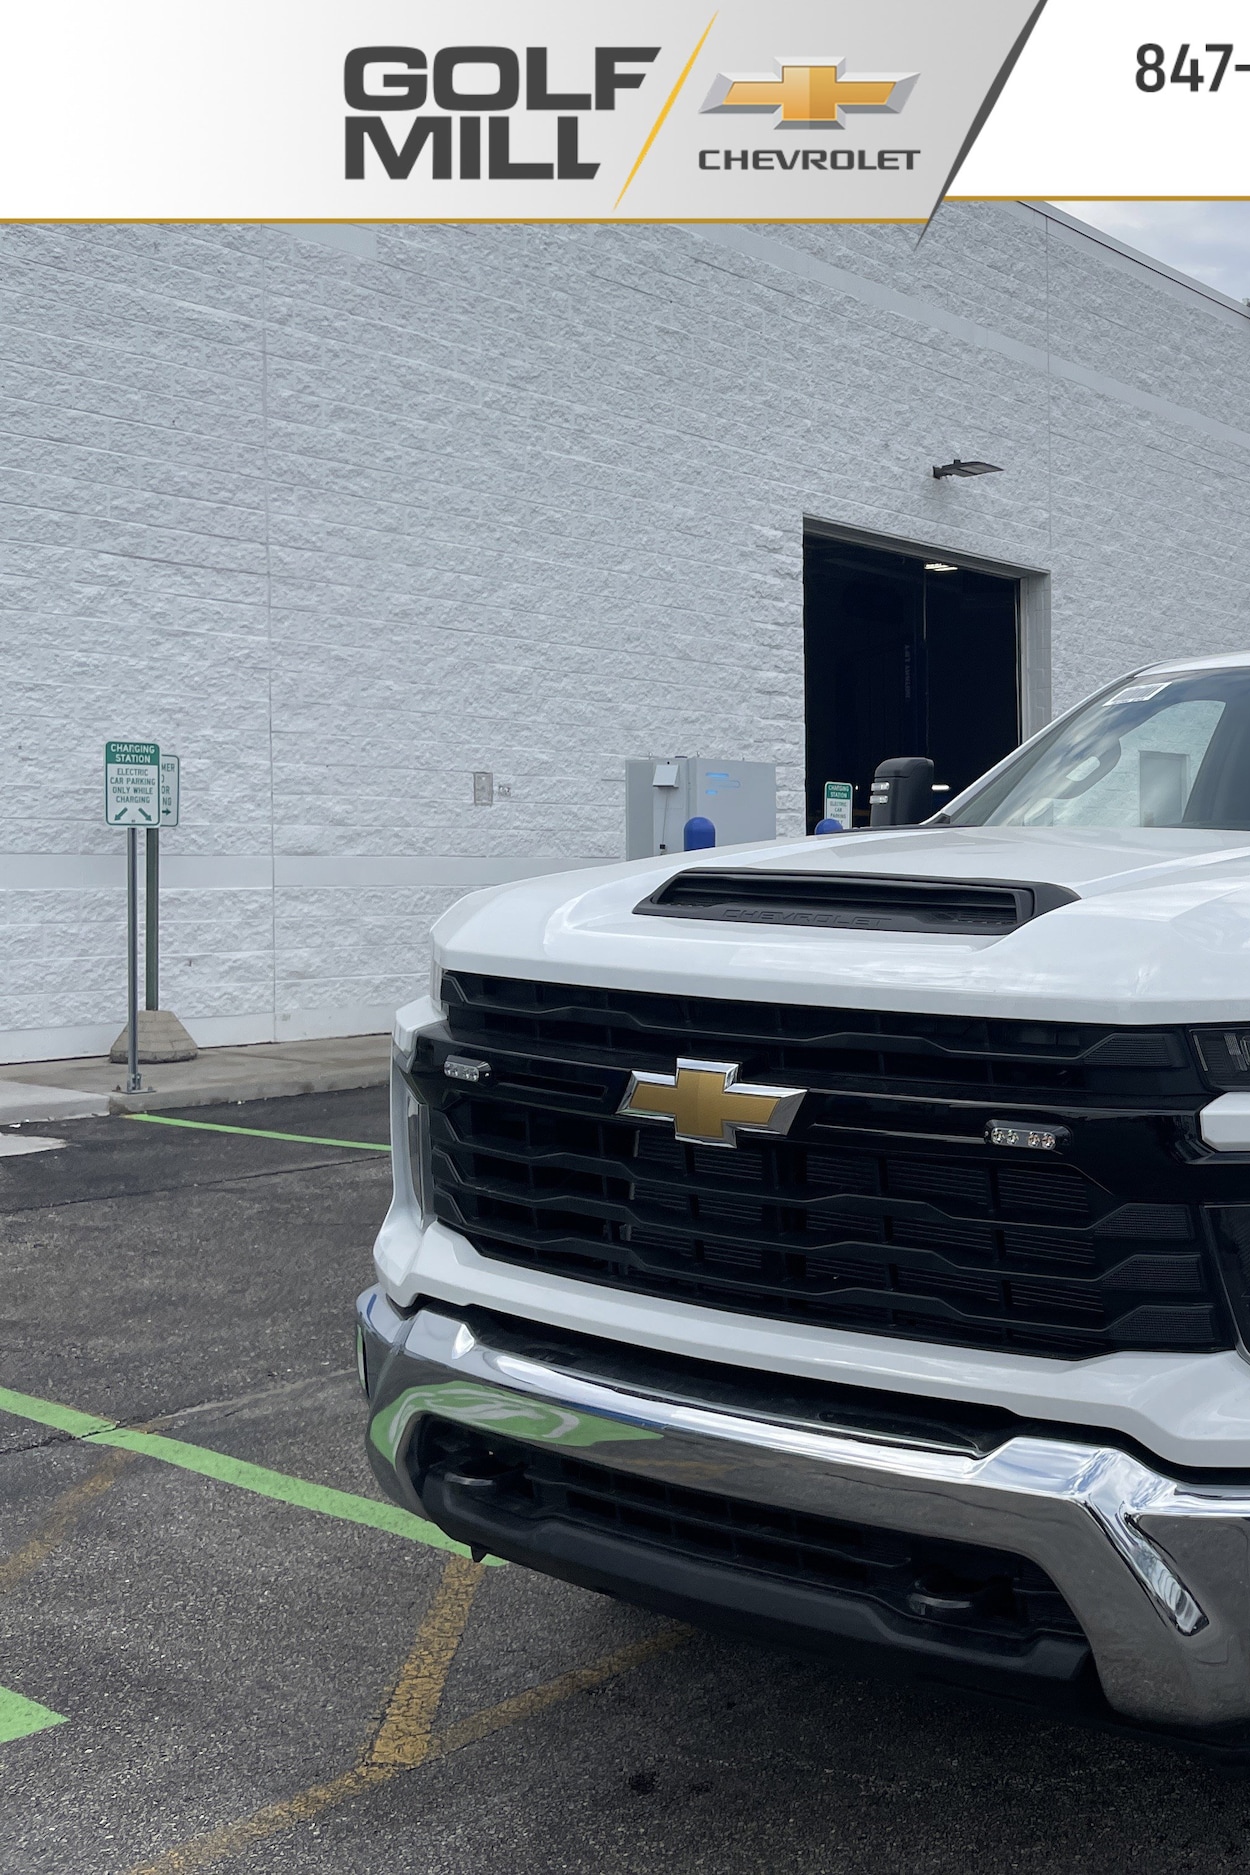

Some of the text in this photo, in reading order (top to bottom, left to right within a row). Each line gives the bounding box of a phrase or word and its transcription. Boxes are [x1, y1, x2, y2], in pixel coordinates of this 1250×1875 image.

[110, 743, 155, 754] CHARGING
[115, 754, 151, 763] STATION
[117, 768, 148, 776] ELECTRIC
[110, 777, 124, 785] CAR
[126, 777, 156, 786] PARKING
[112, 786, 153, 795] ONLY WHILE
[115, 796, 150, 804] CHARGING
